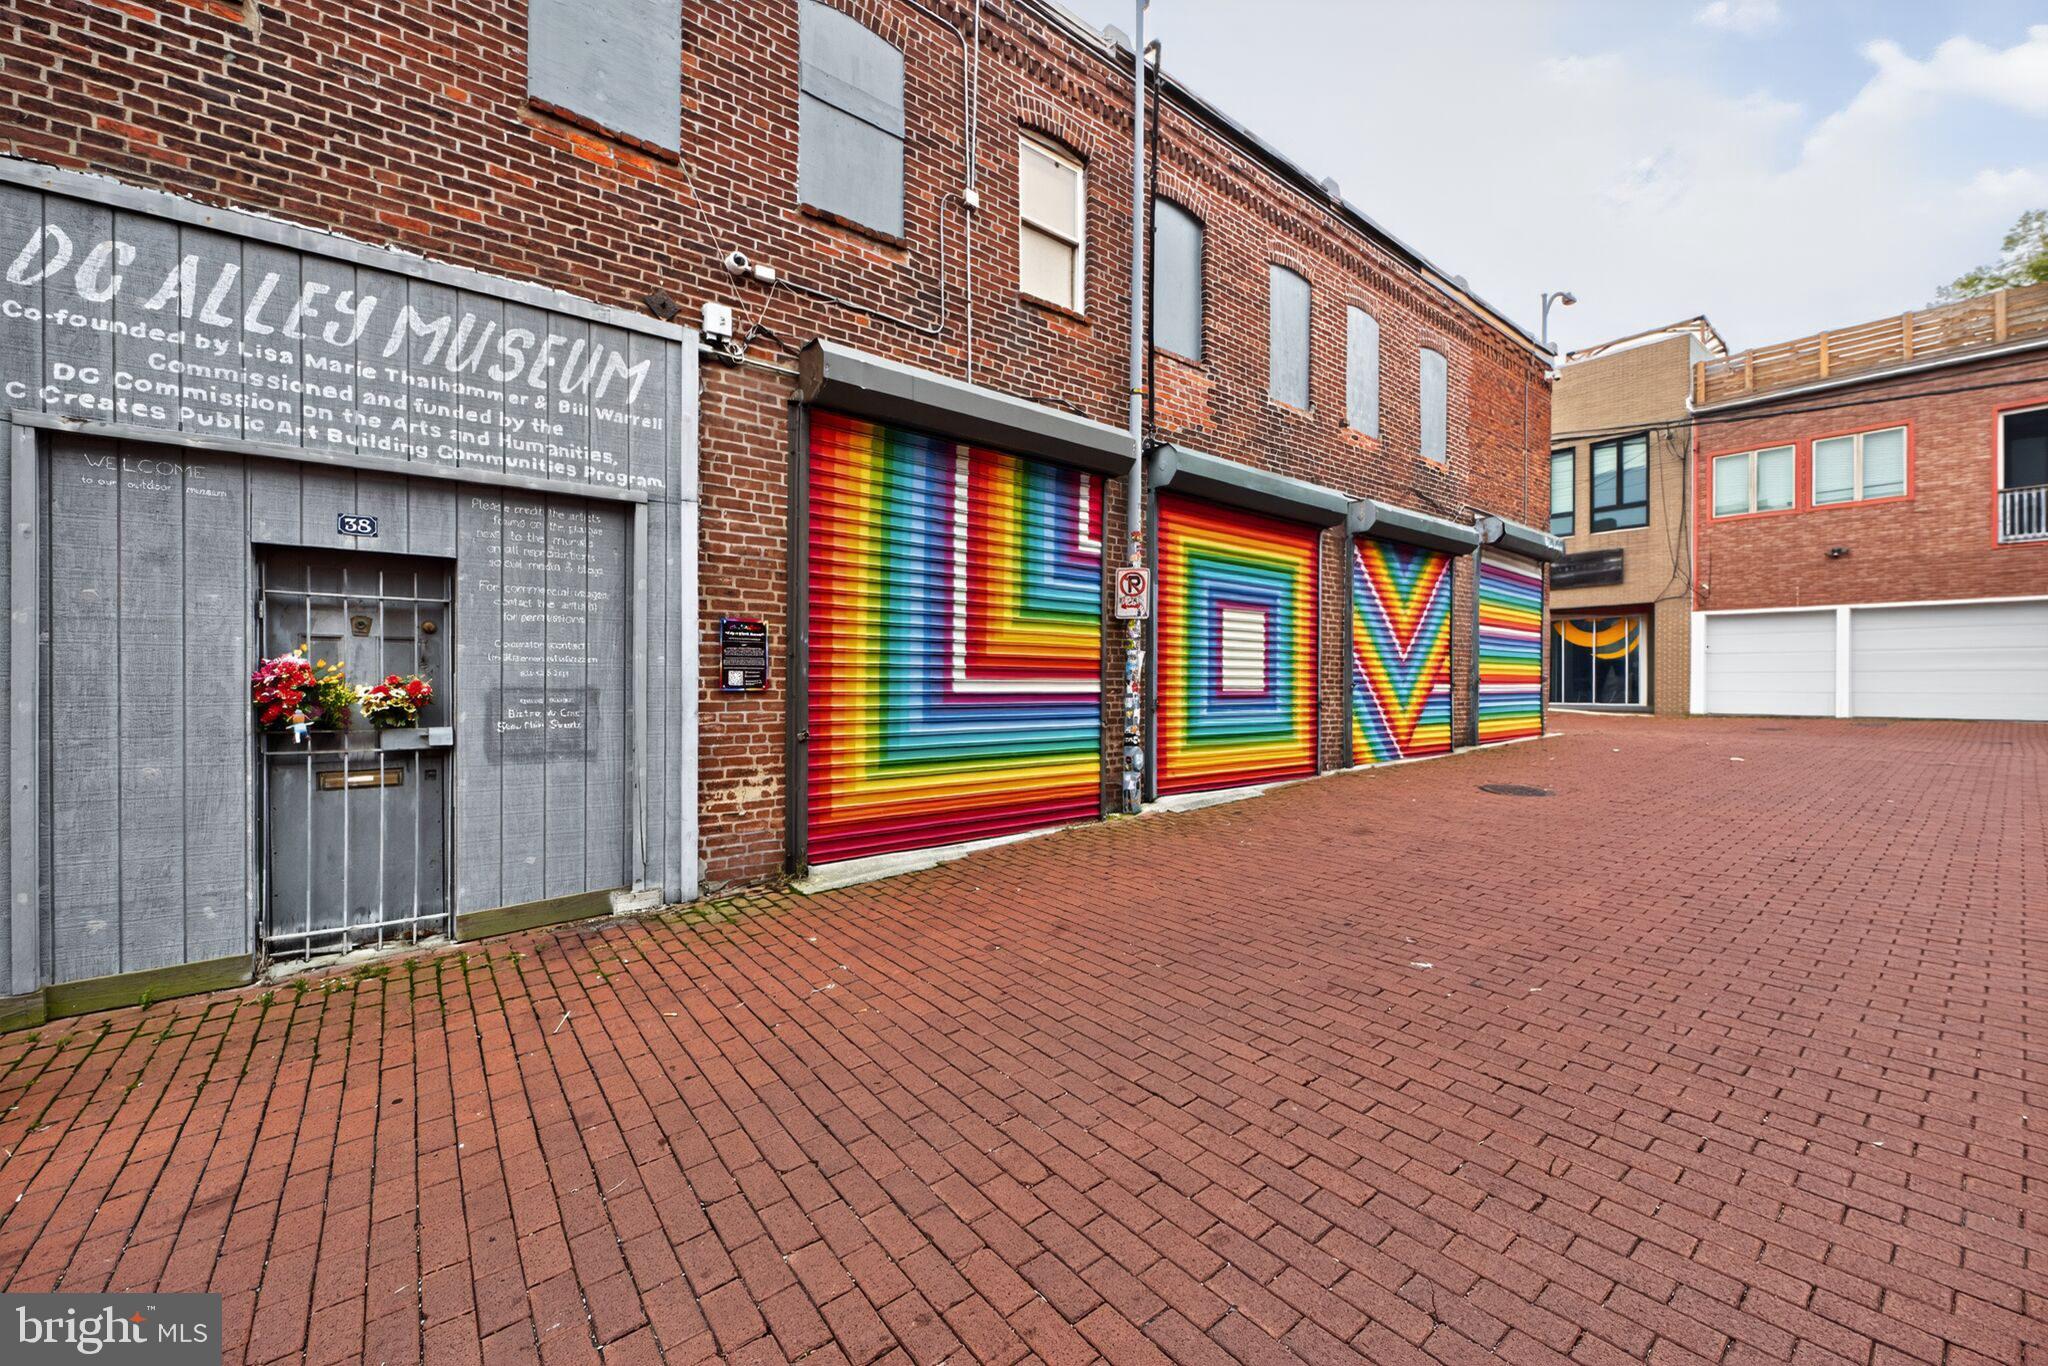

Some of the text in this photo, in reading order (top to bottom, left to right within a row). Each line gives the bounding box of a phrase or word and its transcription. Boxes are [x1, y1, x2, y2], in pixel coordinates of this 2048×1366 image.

[6, 223, 652, 405] DC ALLEY MUSEUM
[2, 299, 186, 346] Co-founded
[194, 333, 230, 357] by
[238, 341, 294, 366] Lisa
[305, 353, 377, 380] Marie
[384, 367, 529, 406] Thalhammer
[534, 394, 547, 411] &
[594, 406, 663, 431] Warrell
[148, 352, 564, 436] Commissioned and funded by the
[53, 362, 618, 467] DC Commission on the Arts and Humanities,
[38, 385, 167, 420] Creates
[179, 406, 266, 432] Public
[275, 420, 320, 440] Art
[327, 428, 429, 459] Building
[437, 444, 577, 478] Communities
[83, 453, 207, 479] WELCOME
[81, 474, 93, 484] to
[127, 480, 173, 491] outdoor
[471, 498, 511, 513] Please
[344, 517, 372, 533] 38
[510, 529, 524, 542] to
[527, 531, 546, 544] the
[478, 579, 502, 592] For
[503, 612, 517, 622] for
